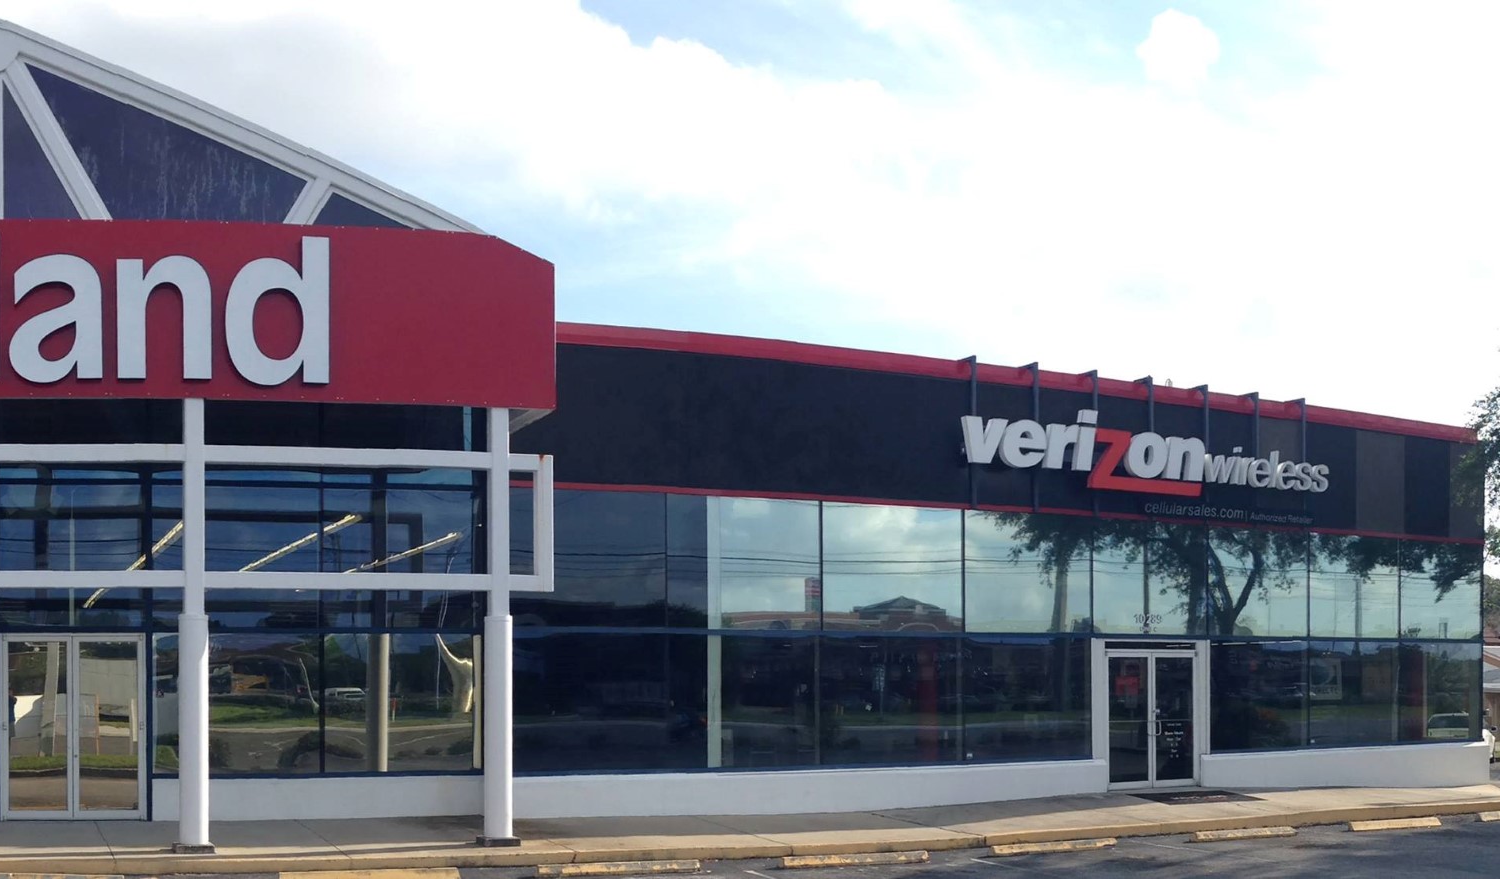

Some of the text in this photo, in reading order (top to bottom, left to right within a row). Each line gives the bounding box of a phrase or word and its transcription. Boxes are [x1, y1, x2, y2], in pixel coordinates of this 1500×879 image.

[960, 409, 1330, 497] verizon wireless
[1144, 501, 1244, 520] cellularsales.com
